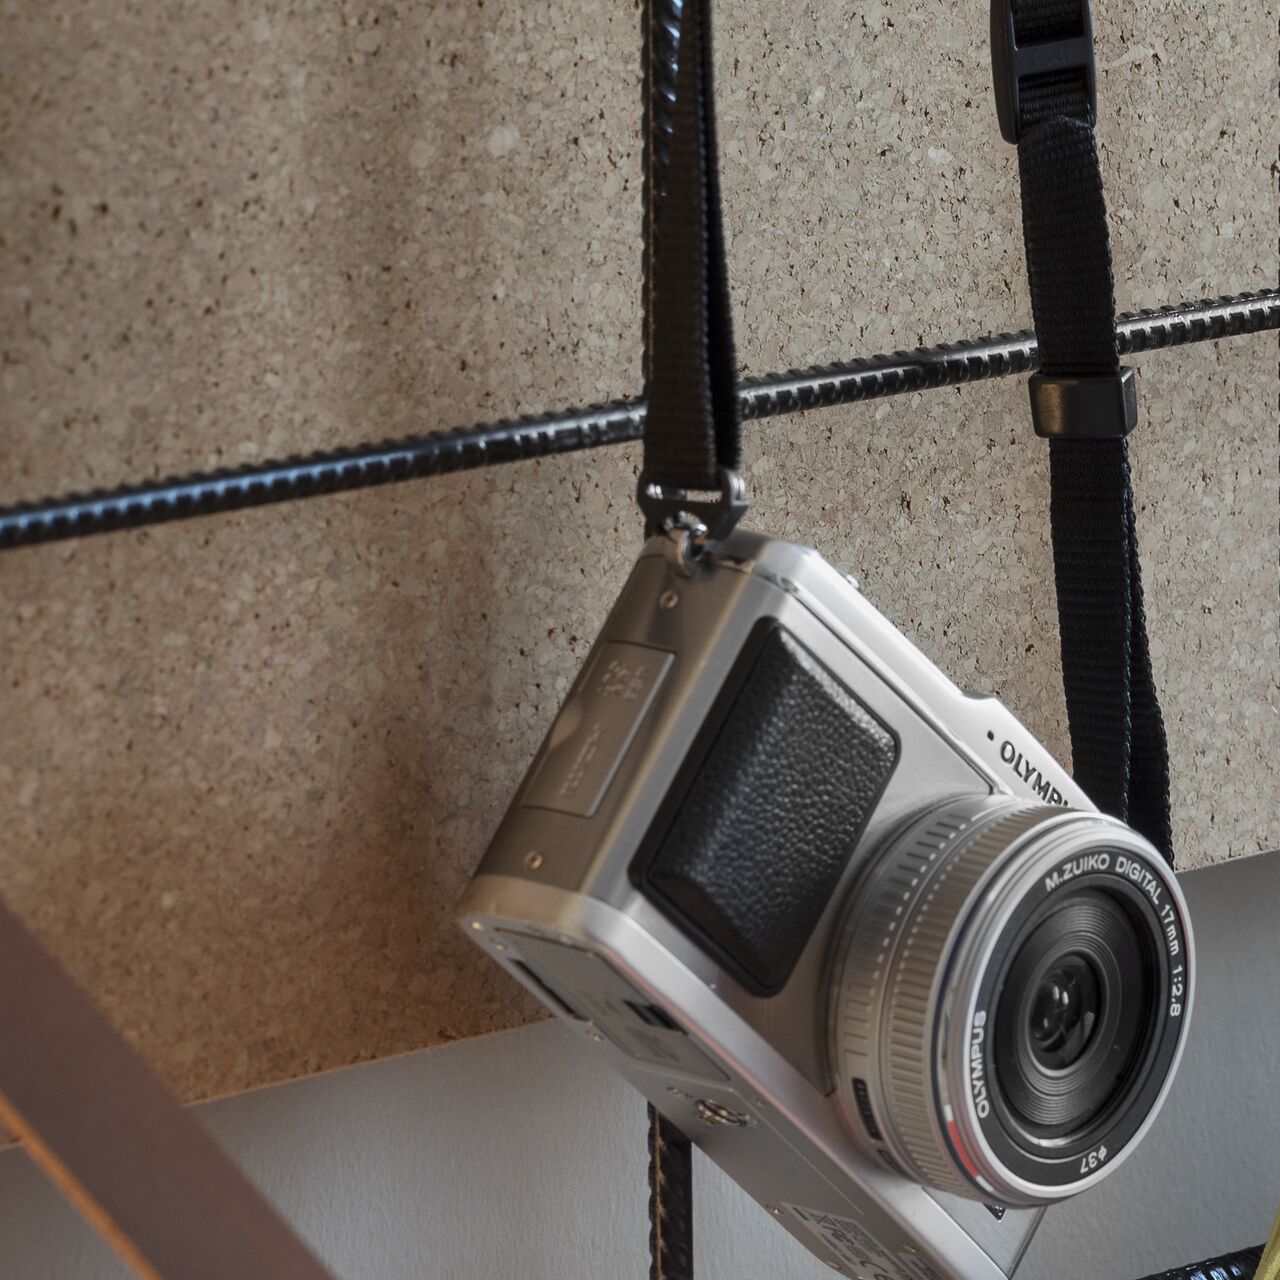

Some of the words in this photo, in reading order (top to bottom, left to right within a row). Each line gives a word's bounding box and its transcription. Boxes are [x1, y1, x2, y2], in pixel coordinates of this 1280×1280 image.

[1000, 740, 1069, 806] OLYMP
[1045, 853, 1110, 891] M.ZUIKO
[1115, 855, 1160, 904] DIGITAL
[1160, 904, 1179, 956] 17mm
[970, 1010, 990, 1119] OLYMPUS
